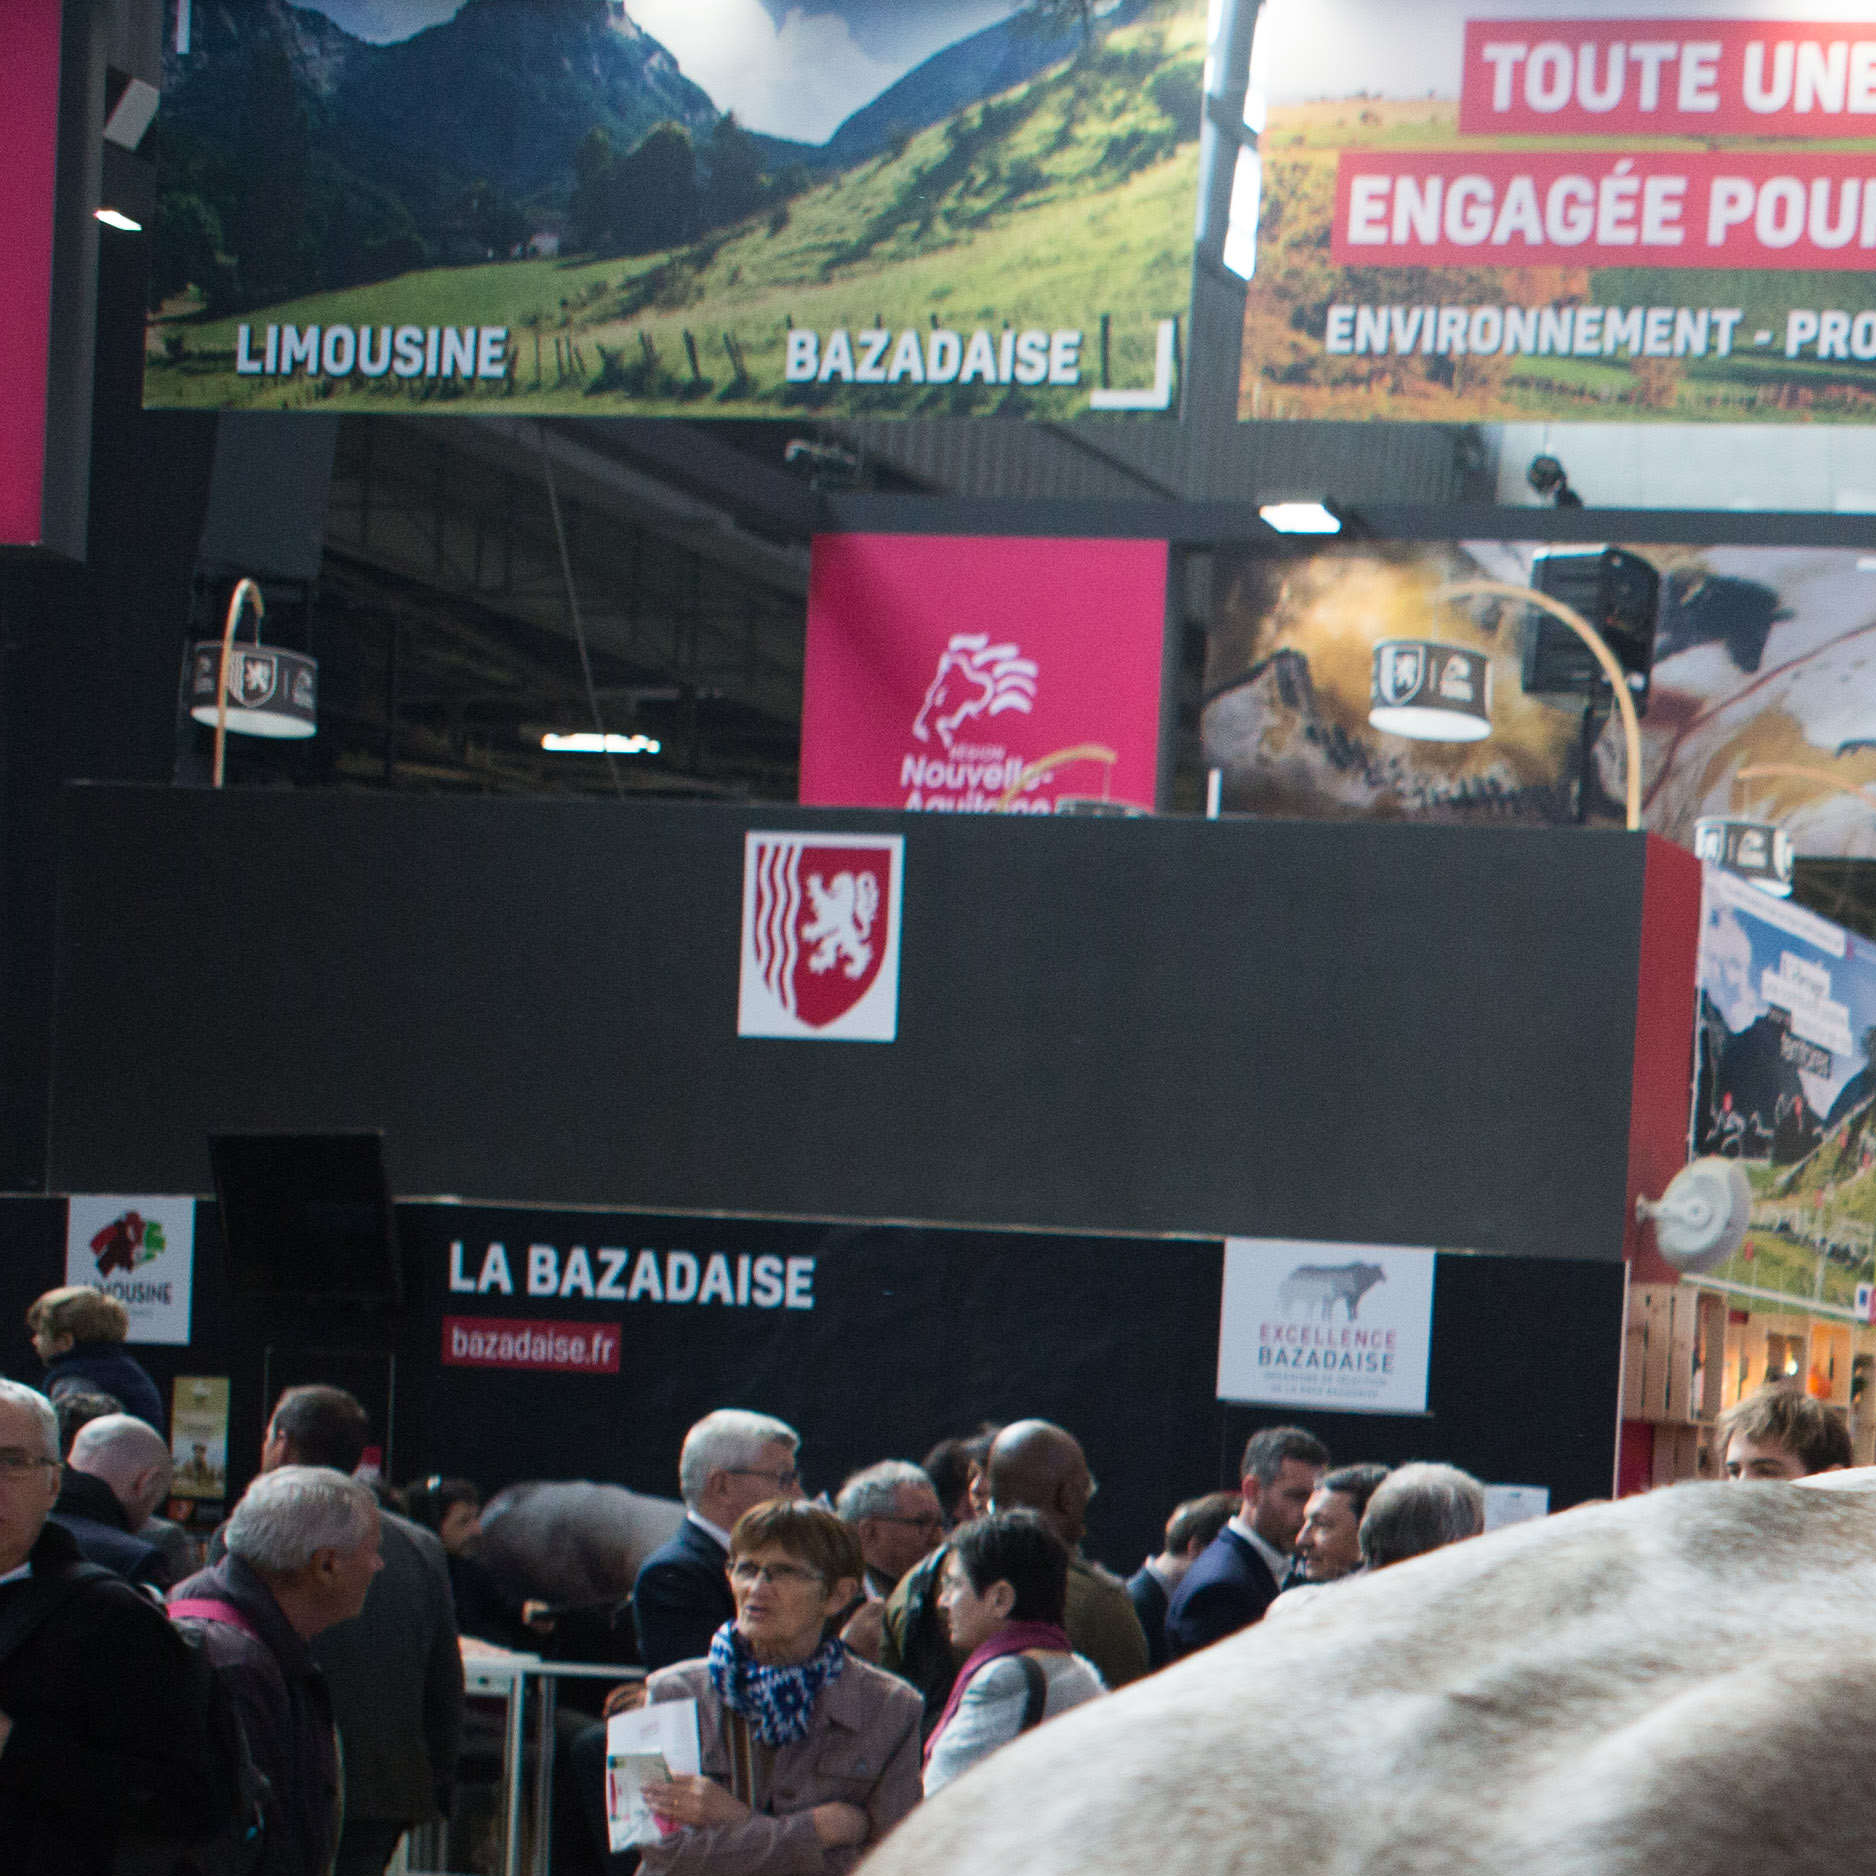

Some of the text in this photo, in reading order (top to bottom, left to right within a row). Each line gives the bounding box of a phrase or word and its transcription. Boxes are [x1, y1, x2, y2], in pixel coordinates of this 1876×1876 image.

[1482, 40, 1722, 112] TOUTE
[1347, 158, 1689, 247] ENGAGÉE
[236, 323, 509, 378] LIMOUSINE
[785, 328, 1084, 385] BAZADAISE
[1325, 304, 1744, 358] ENVIRONNEMENT
[449, 1240, 816, 1310] LA BAZADAISE
[452, 1325, 615, 1366] bazadaise.fr
[1258, 1345, 1395, 1374] BAZADAISE
[1259, 1322, 1397, 1350] EXCELLENCE
